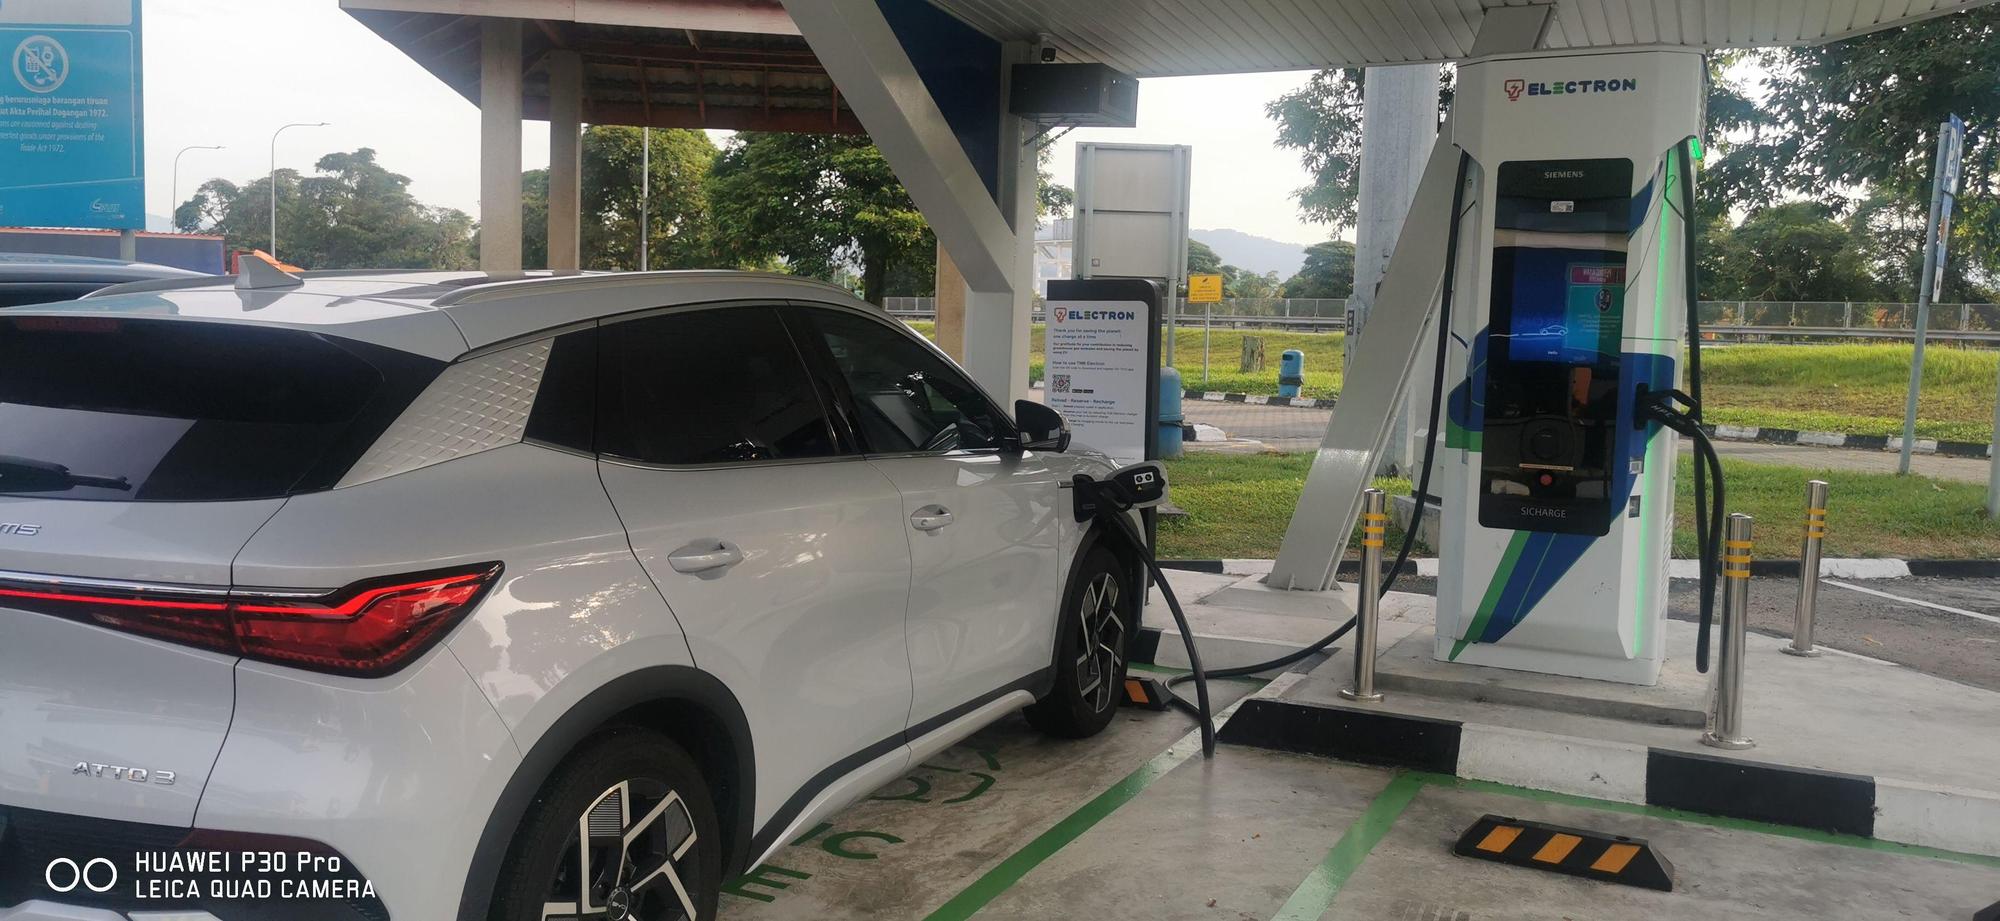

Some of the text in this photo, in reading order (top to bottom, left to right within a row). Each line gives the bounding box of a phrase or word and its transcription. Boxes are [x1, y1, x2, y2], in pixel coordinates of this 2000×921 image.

[1527, 78, 1637, 96] ELECTRON
[26, 107, 52, 116] Perihal
[53, 108, 88, 118] Dagangan
[1544, 170, 1584, 179] SIEMENS
[1068, 310, 1135, 320] ELECTRON
[1520, 506, 1566, 518] SICHARGE
[71, 761, 177, 786] ATTO 3
